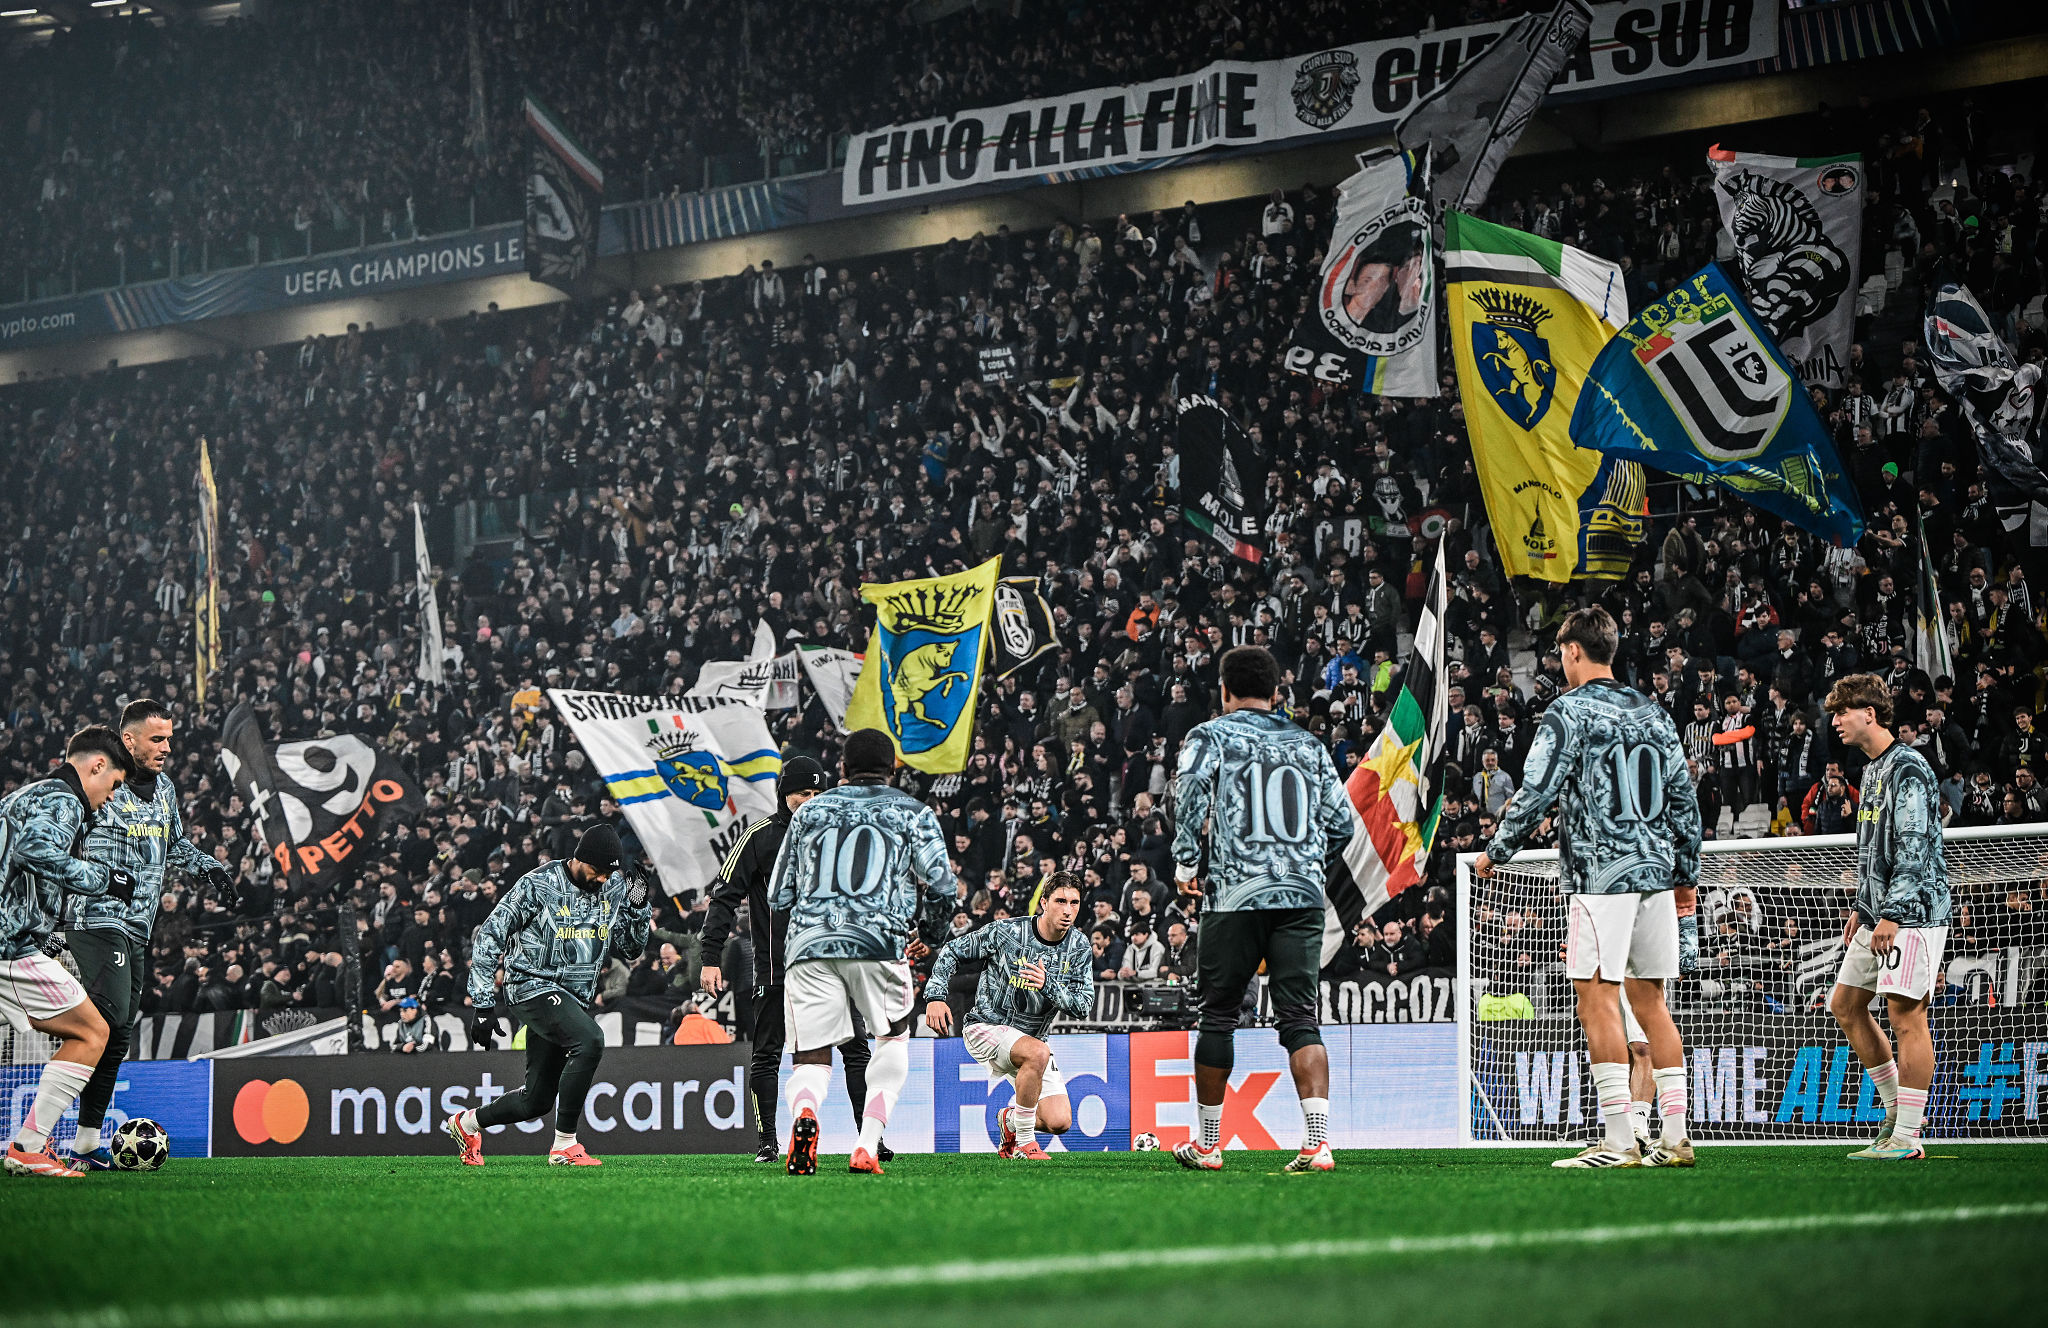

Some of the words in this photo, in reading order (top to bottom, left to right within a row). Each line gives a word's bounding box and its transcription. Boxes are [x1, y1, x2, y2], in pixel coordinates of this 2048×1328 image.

[1303, 53, 1333, 73] CURVA
[1334, 52, 1353, 65] SUD
[1372, 25, 1594, 114] CURA
[1612, 0, 1754, 76] SUD
[859, 118, 984, 197] FINO
[993, 96, 1128, 173] ALLA
[1140, 71, 1258, 152] FINE
[1300, 109, 1317, 125] FINO
[1317, 116, 1333, 127] ALLA
[1332, 101, 1351, 120] FINE
[284, 267, 342, 296] UEFA
[349, 243, 485, 288] CHAMPIONS
[494, 237, 525, 264] LE
[1200, 491, 1259, 536] MOLE
[1522, 535, 1556, 551] MOLE
[1242, 761, 1308, 843] 10
[1608, 743, 1664, 822] 10
[127, 823, 163, 838] Allianz
[808, 824, 886, 898] 10
[555, 926, 596, 940] Allianz
[329, 1065, 746, 1138] mastcard
